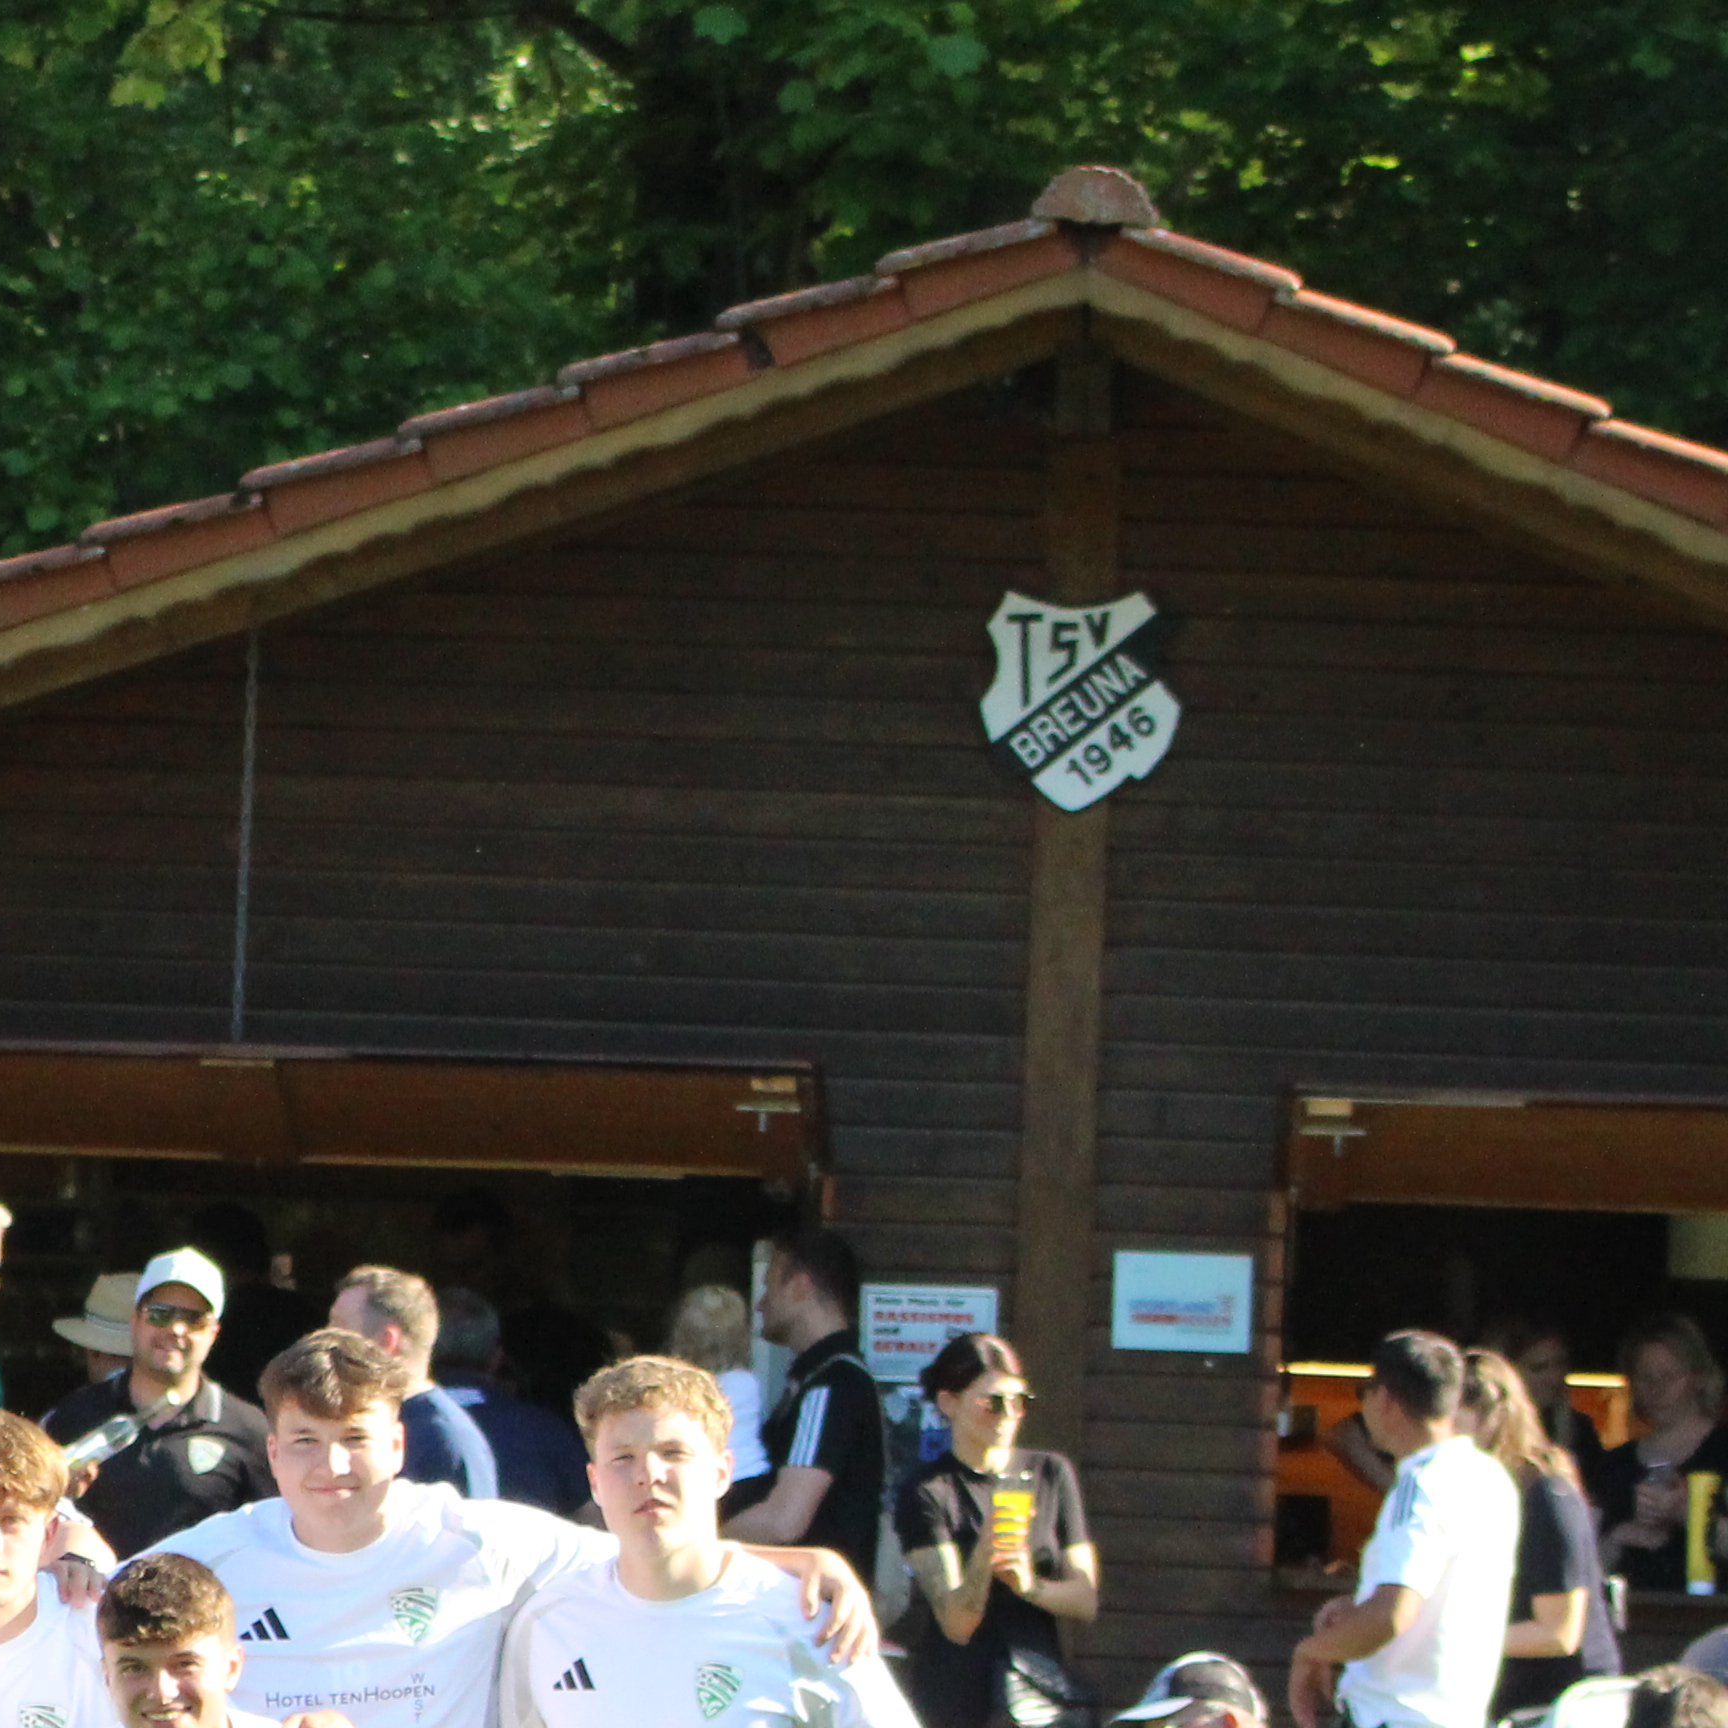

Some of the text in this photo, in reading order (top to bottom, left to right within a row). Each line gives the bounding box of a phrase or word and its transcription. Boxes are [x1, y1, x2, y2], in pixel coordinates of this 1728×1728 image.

[1005, 611, 1112, 708] TSV
[1008, 653, 1148, 769] BREUNA
[1066, 706, 1157, 786] 1946
